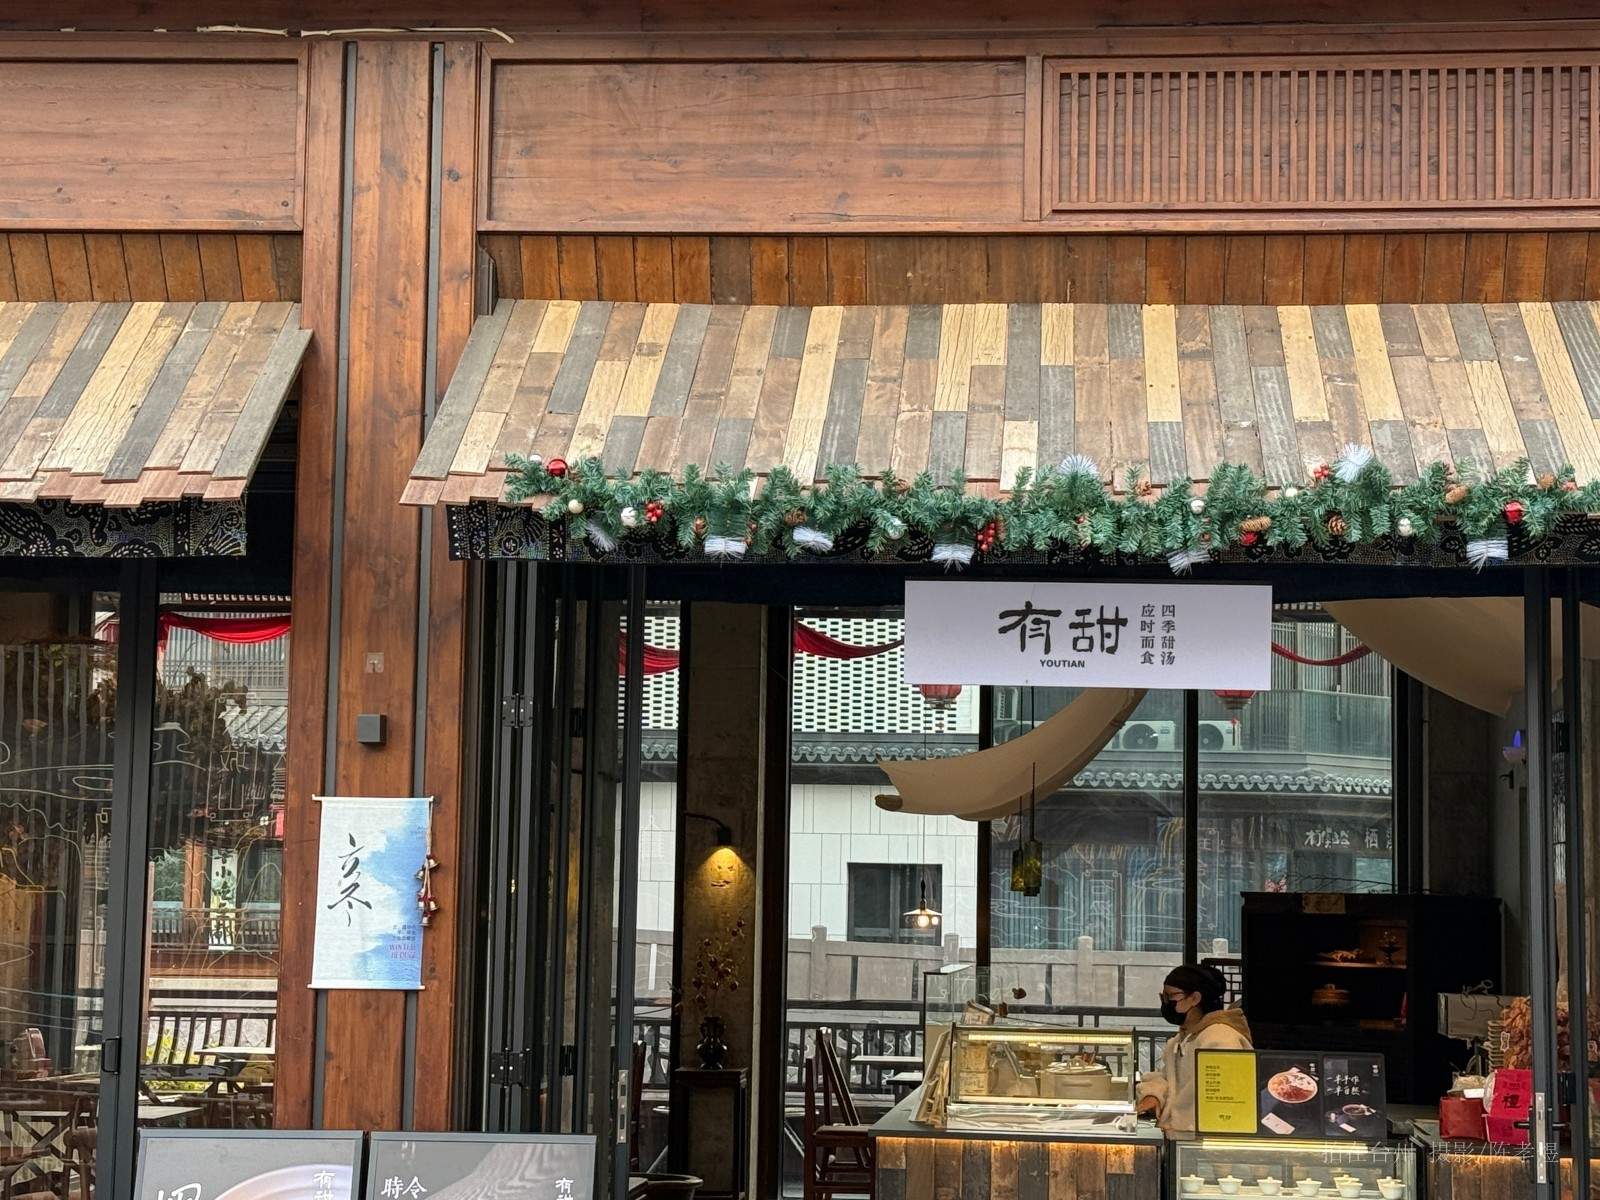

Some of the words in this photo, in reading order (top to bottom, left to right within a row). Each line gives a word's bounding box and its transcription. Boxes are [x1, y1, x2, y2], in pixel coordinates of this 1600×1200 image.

[998, 601, 1128, 655] 有甜
[1140, 603, 1156, 665] 应时而食
[1161, 604, 1176, 665] 四季甜汤
[1040, 659, 1085, 668] YOUTIAN
[327, 832, 373, 927] 立冬
[381, 1176, 427, 1199] 時令
